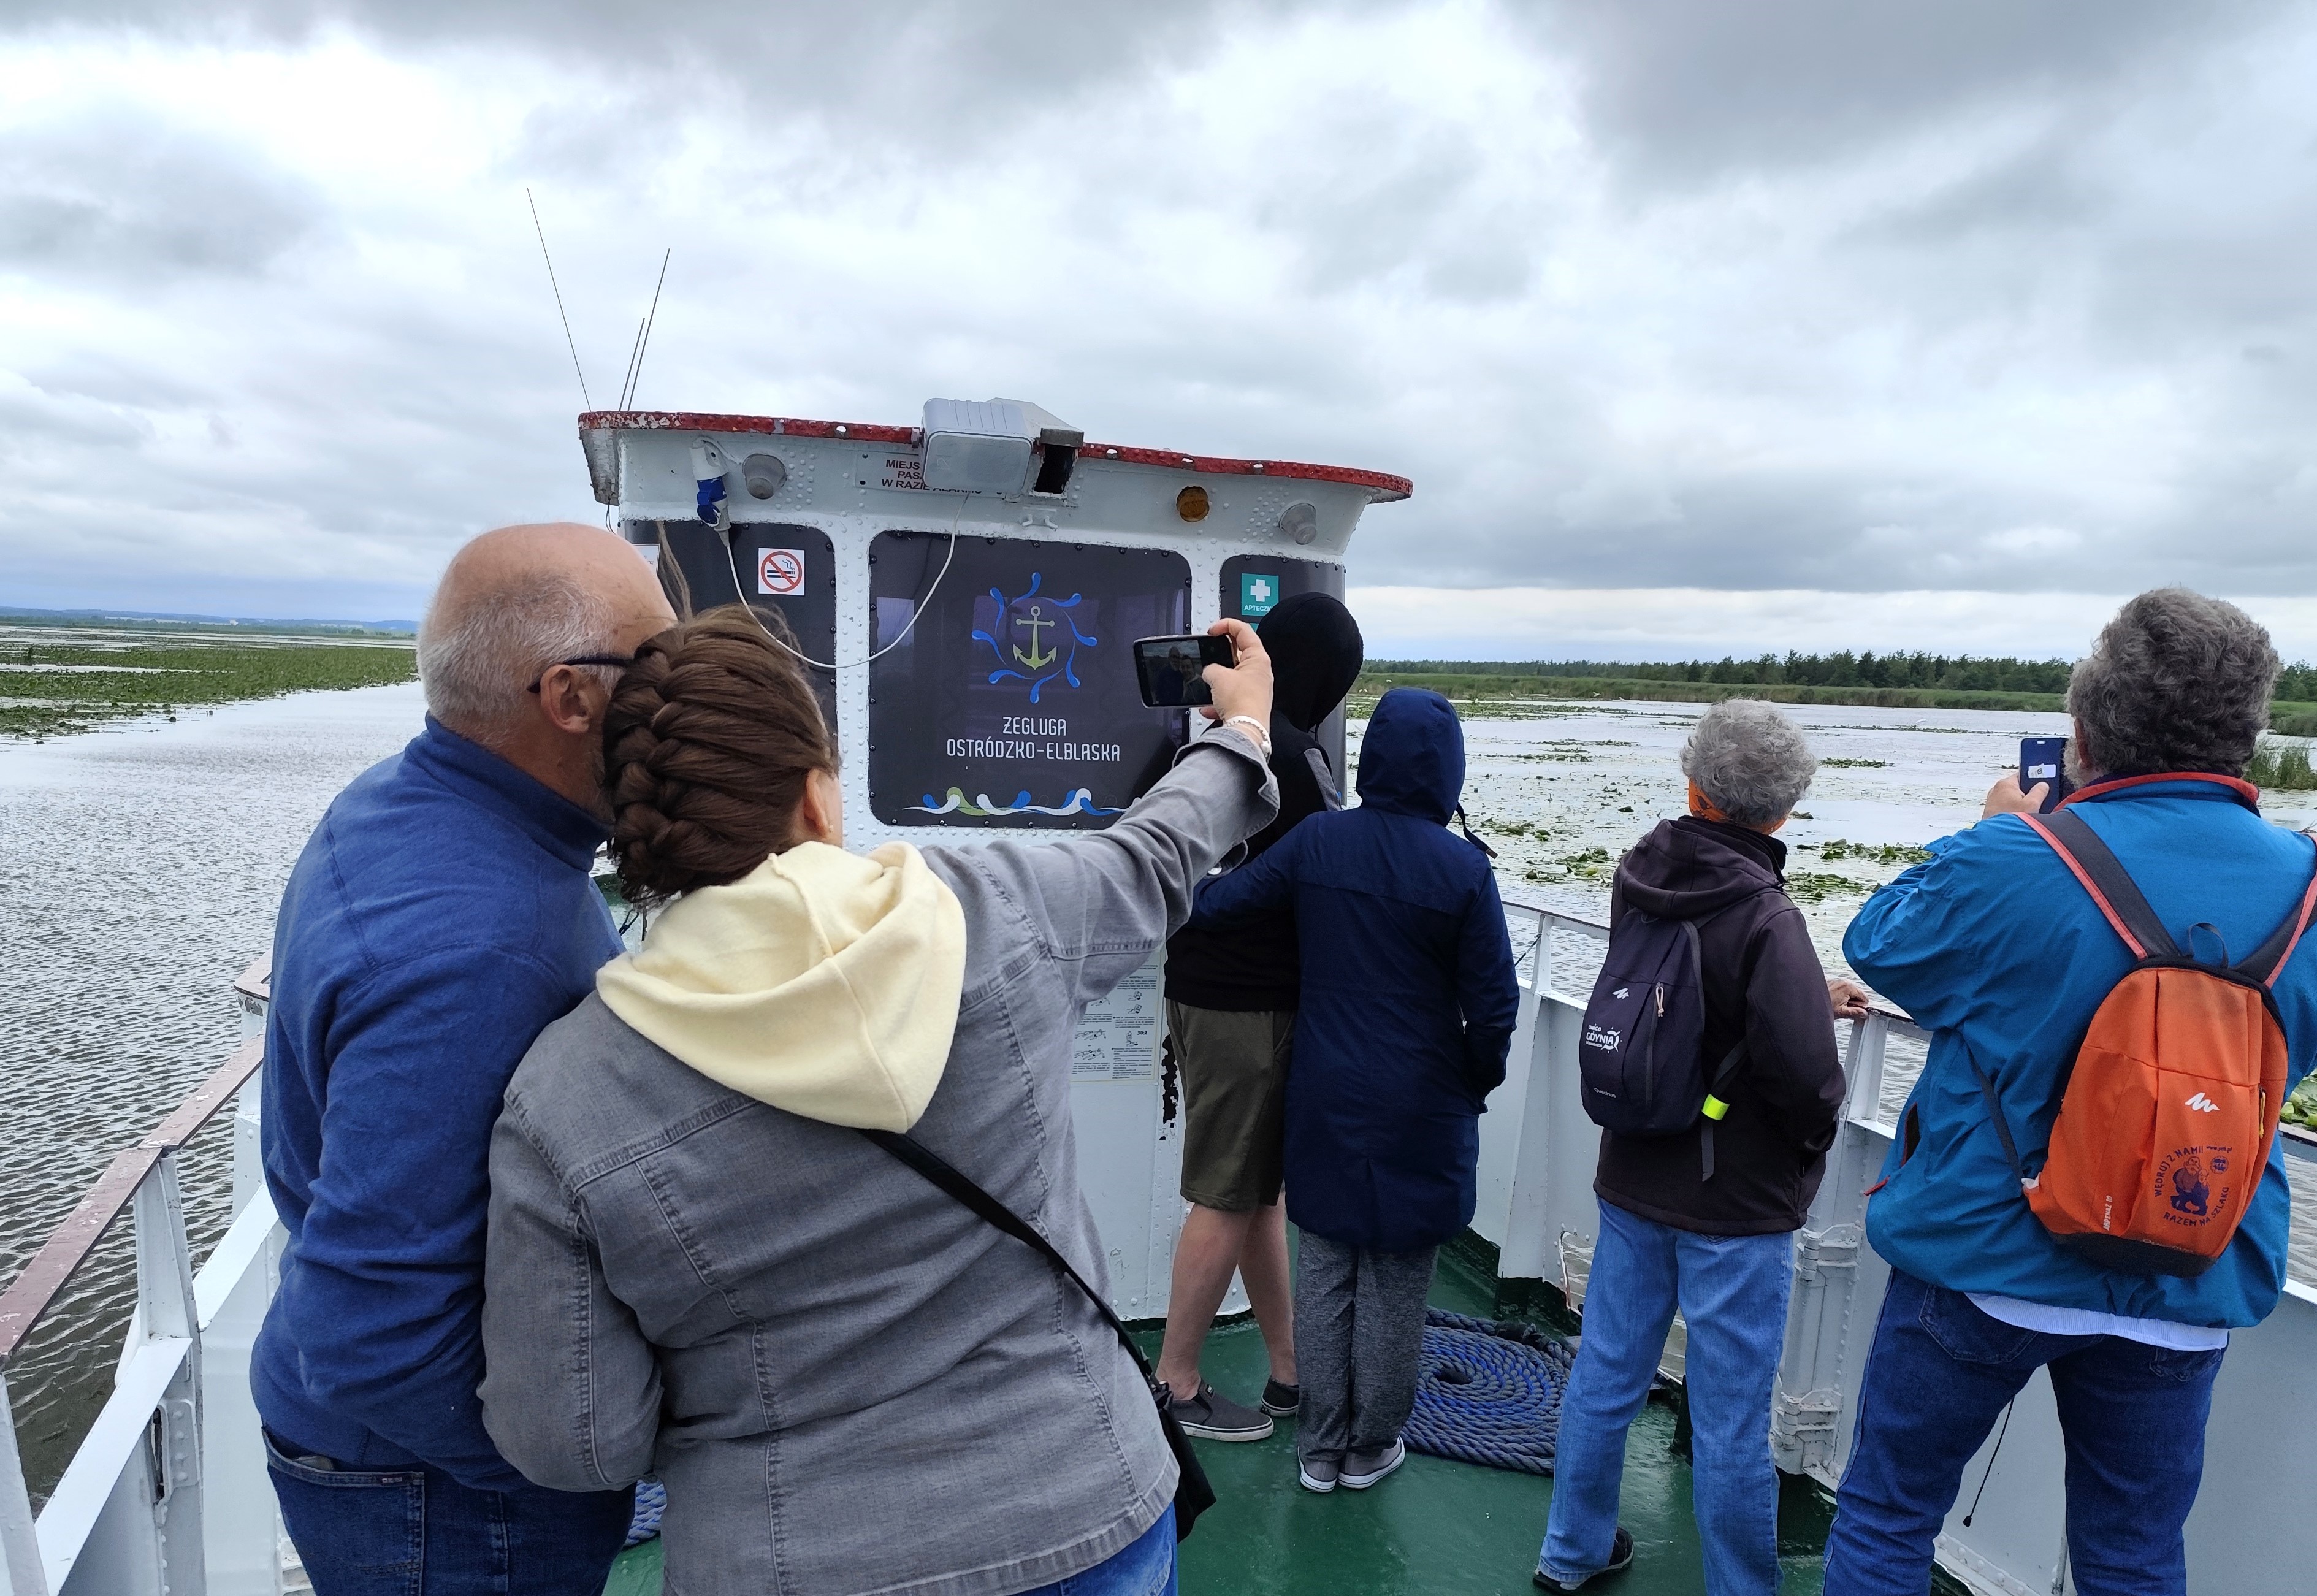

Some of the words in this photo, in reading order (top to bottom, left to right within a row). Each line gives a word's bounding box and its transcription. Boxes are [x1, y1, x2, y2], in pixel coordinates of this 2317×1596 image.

[886, 460, 920, 470] MIEJS
[898, 471, 922, 480] PAS
[882, 479, 893, 487] W
[1586, 1031, 1614, 1045] GDYNIA
[2163, 1212, 2197, 1226] RAZEM
[2199, 1216, 2211, 1227] NA
[2211, 1186, 2229, 1218] SZLAKU
